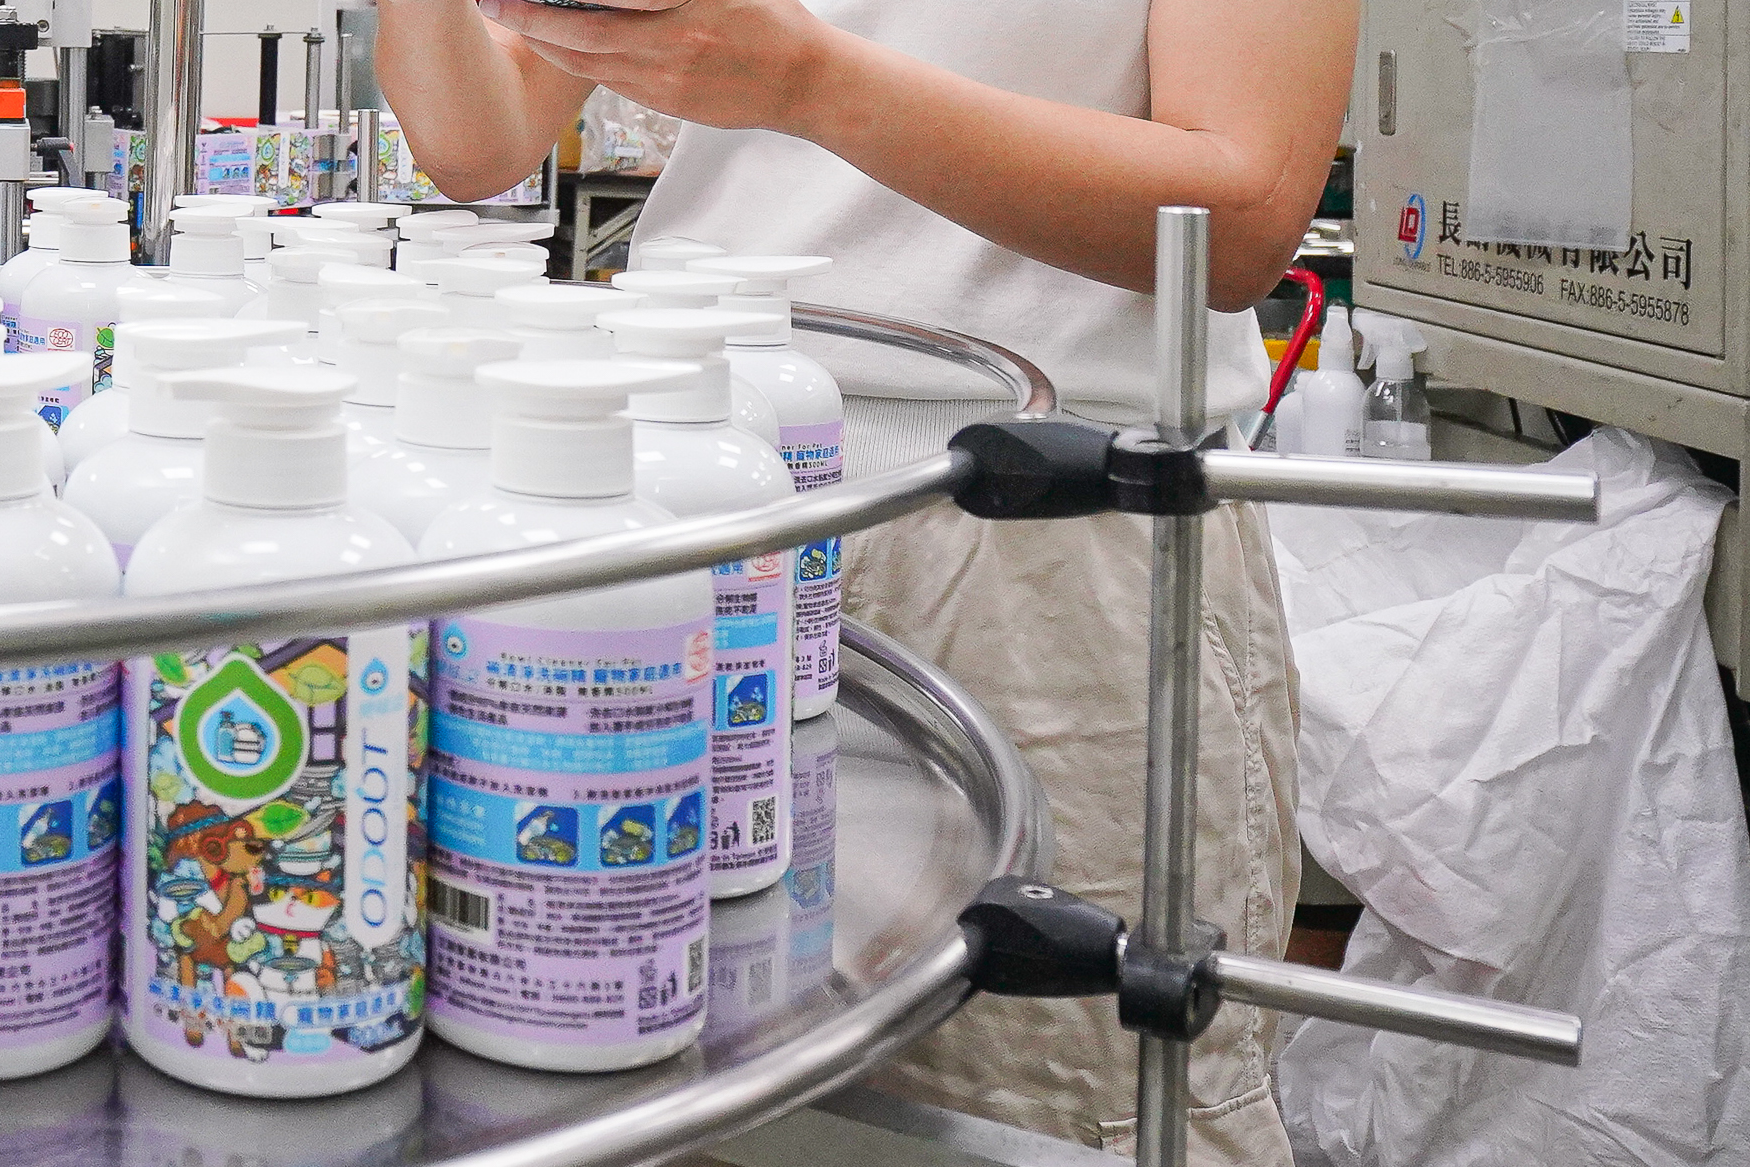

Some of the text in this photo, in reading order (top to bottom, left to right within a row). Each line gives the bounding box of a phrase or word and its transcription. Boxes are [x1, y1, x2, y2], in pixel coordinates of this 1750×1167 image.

[1439, 200, 1693, 291] 長限公司
[1560, 278, 1690, 326] FAX:886-5-5955878
[356, 727, 389, 928] ODOUT
